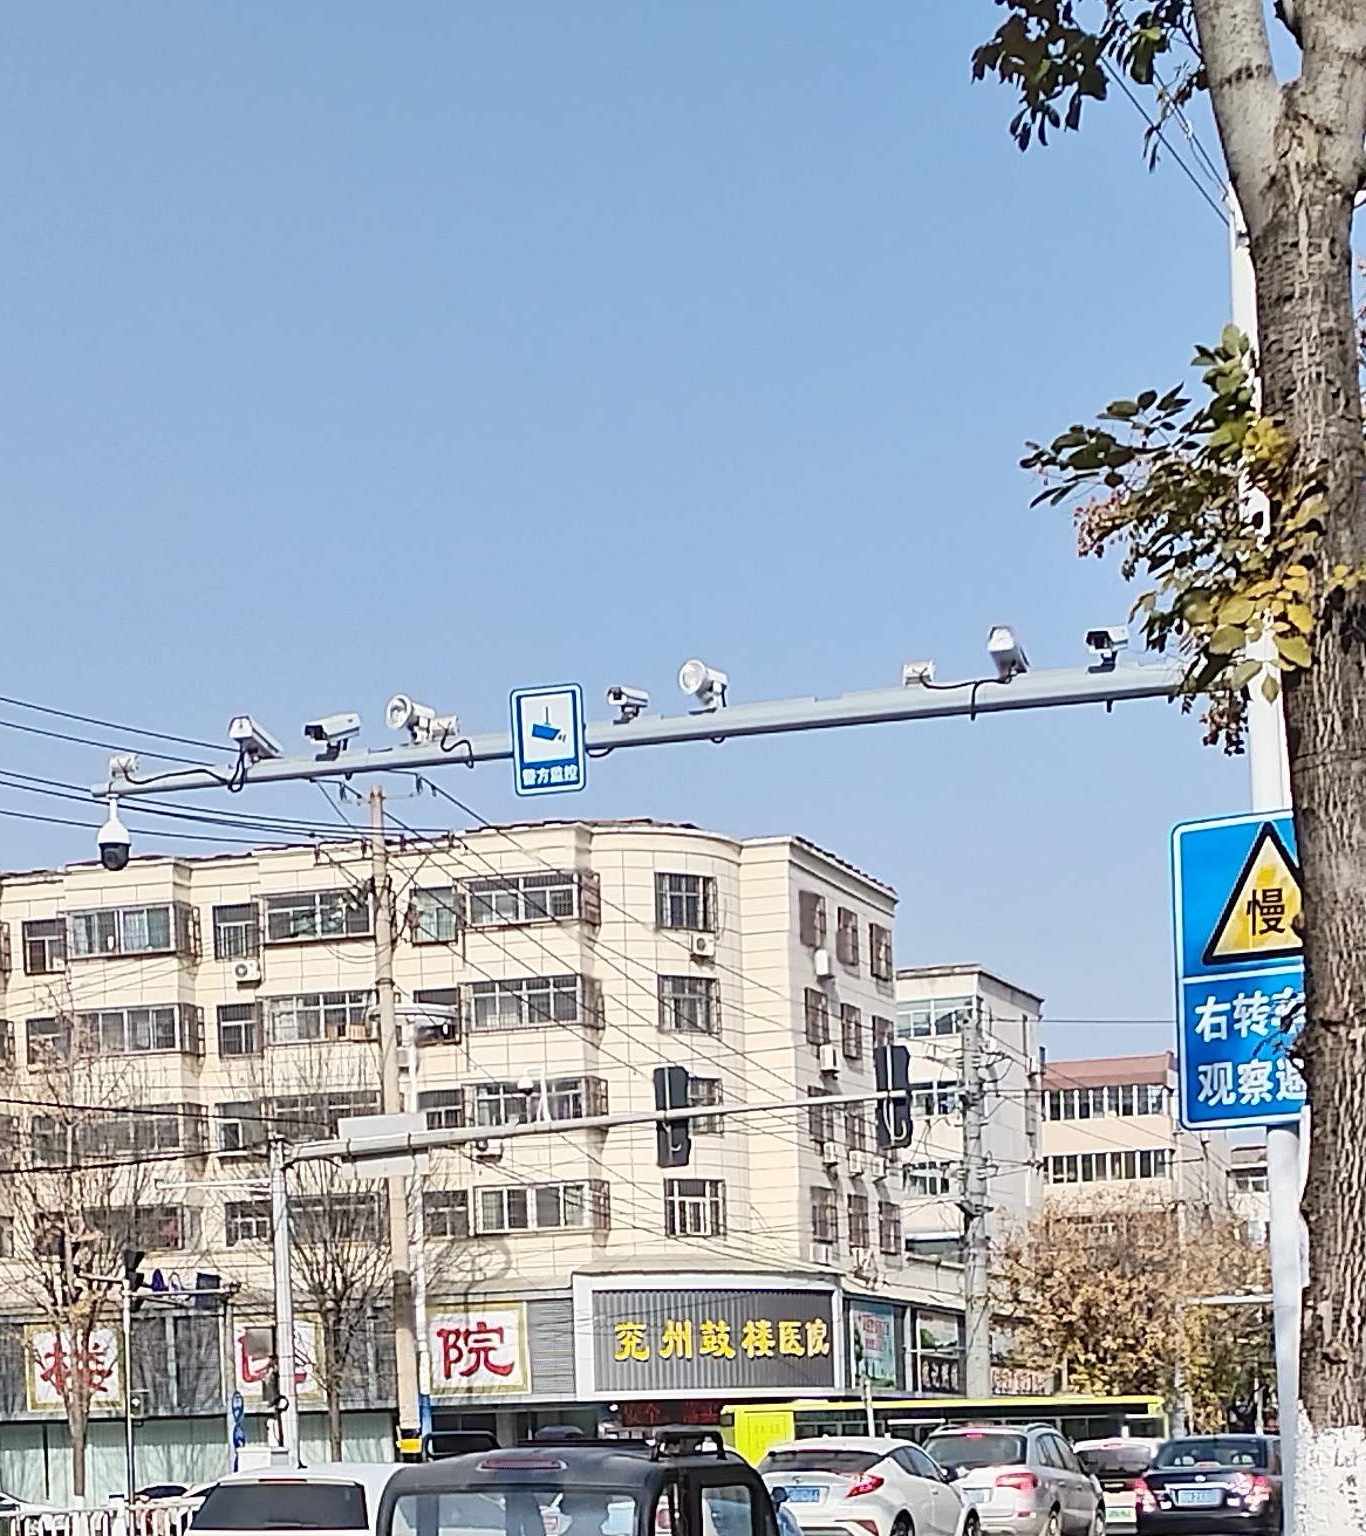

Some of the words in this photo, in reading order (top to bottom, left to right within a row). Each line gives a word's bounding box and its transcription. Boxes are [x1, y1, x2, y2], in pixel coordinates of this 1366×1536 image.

[522, 764, 578, 786] 警方监控
[1246, 888, 1286, 936] 慢
[614, 1317, 831, 1361] 兖州鼓楼医院
